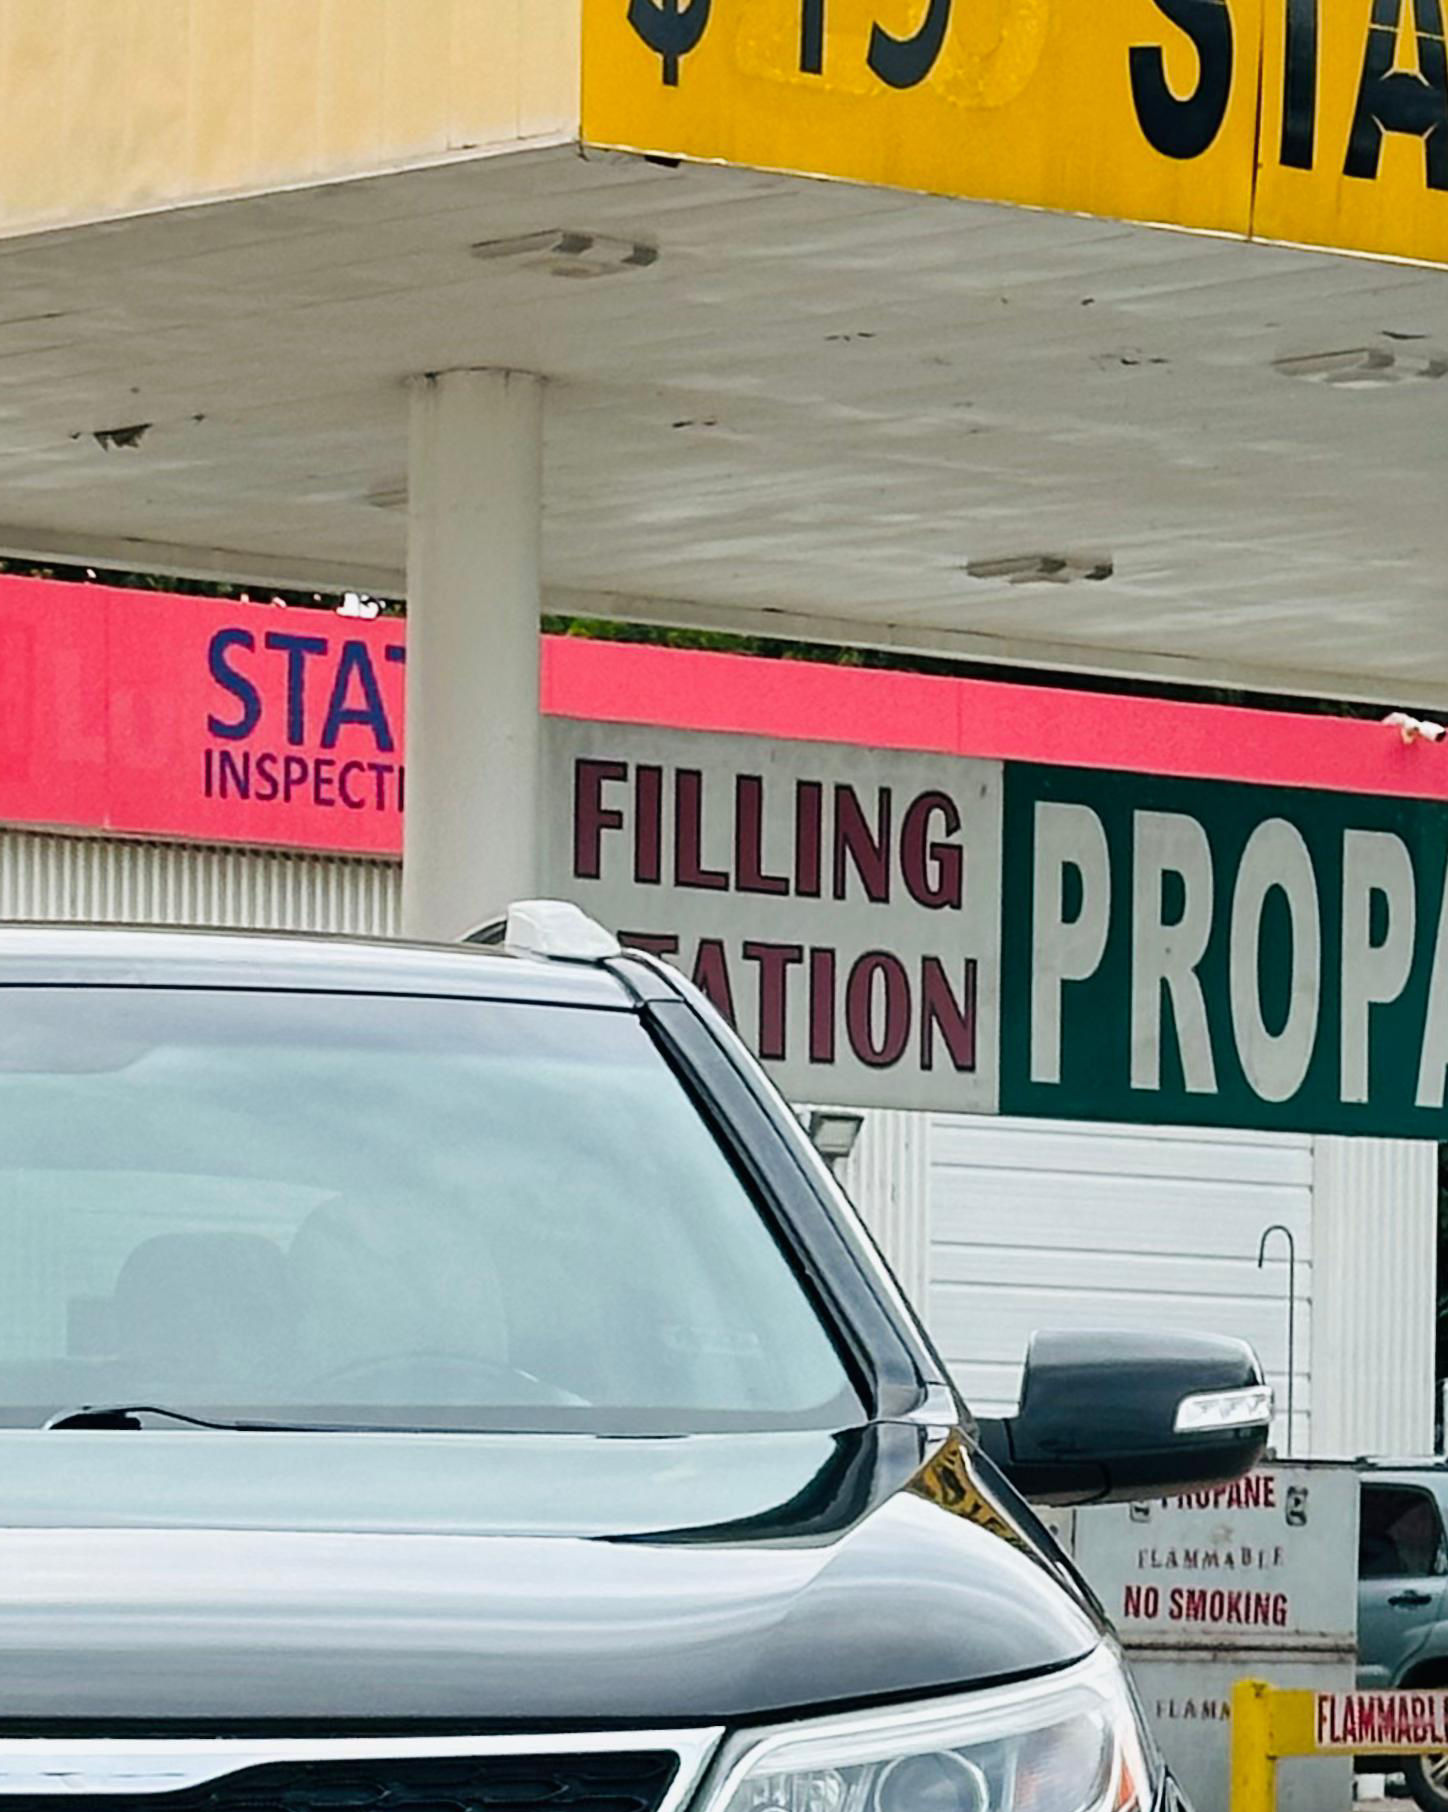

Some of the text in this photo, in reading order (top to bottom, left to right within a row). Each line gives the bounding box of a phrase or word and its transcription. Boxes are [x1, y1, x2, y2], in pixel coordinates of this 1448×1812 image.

[208, 627, 405, 753] STA
[205, 748, 405, 813] INSPECTI
[574, 758, 964, 910] FILLING
[617, 930, 978, 1073] ATION
[1124, 1584, 1289, 1627] NO SMOKING
[1317, 1694, 1448, 1744] FLAMMABL
